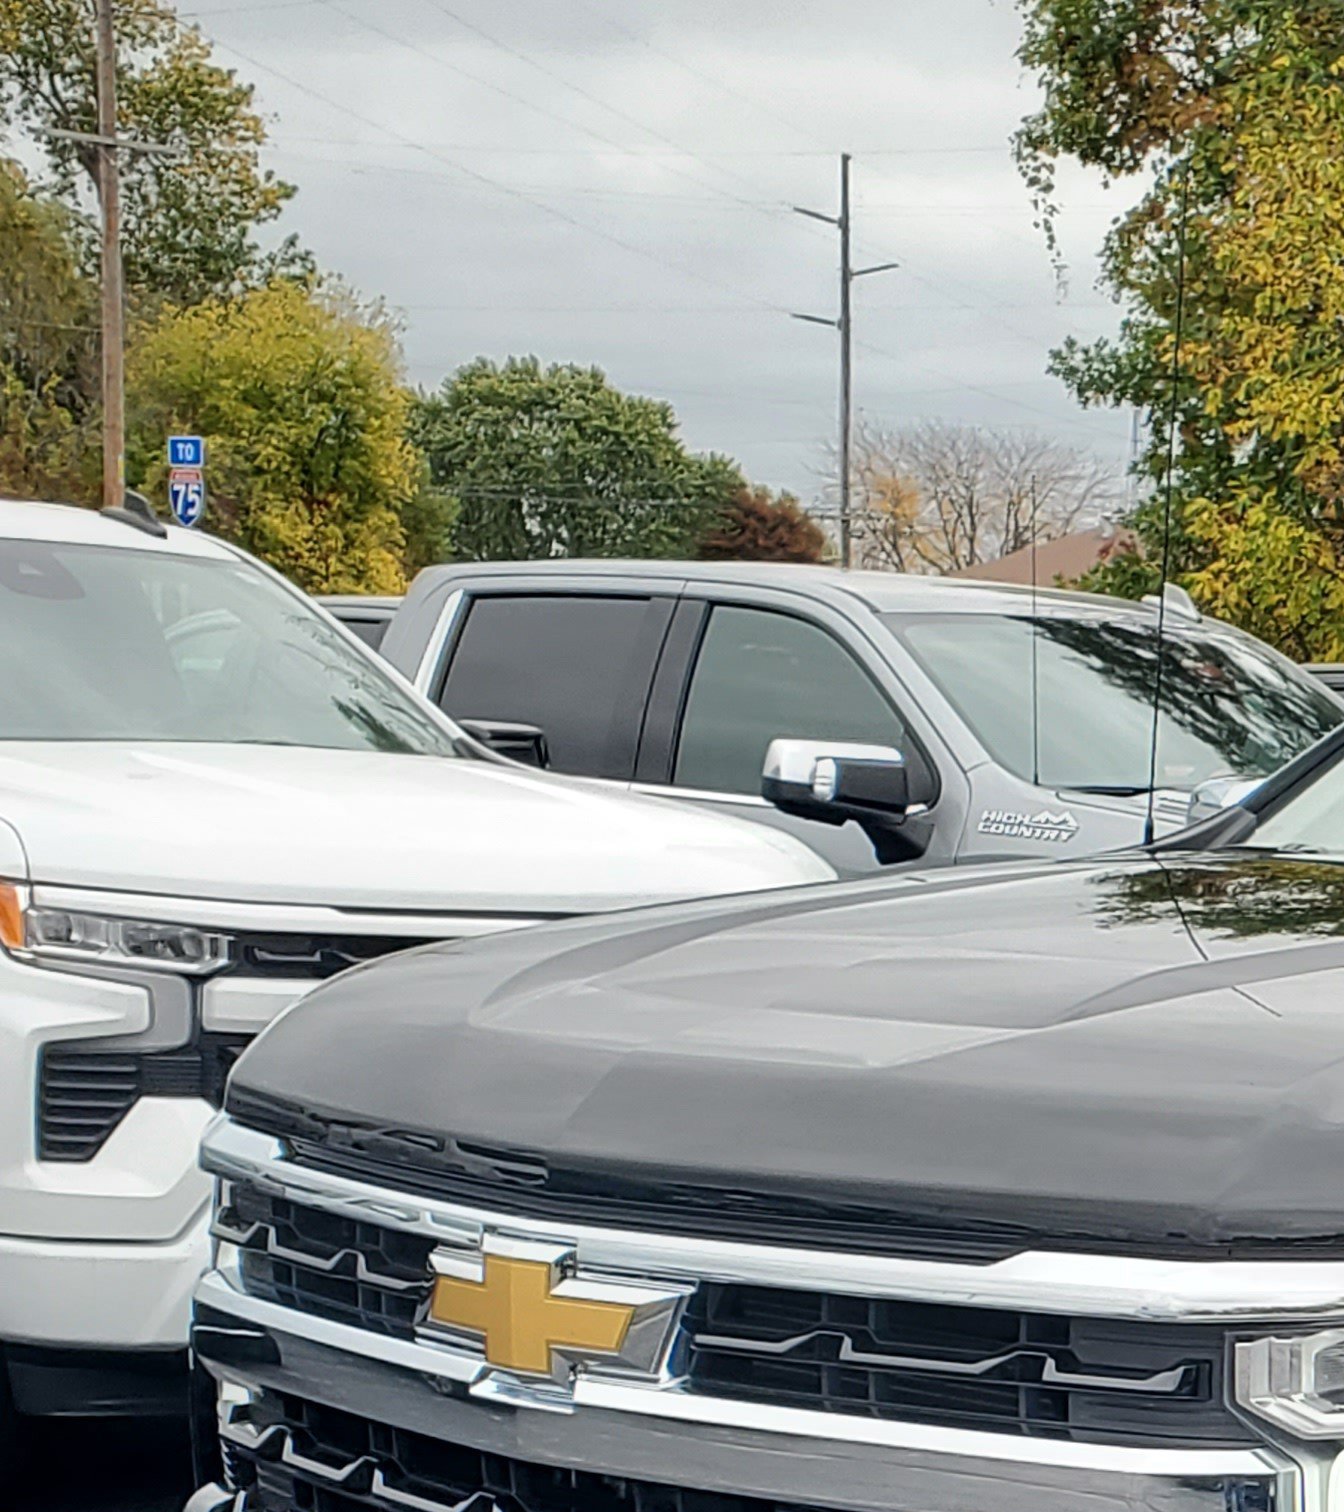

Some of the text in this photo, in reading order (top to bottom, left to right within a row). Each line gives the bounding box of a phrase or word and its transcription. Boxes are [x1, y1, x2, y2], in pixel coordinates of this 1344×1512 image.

[176, 442, 194, 461] TO
[173, 484, 200, 516] 75
[981, 809, 1032, 825] HIGH
[977, 822, 1076, 842] COUNTRY
